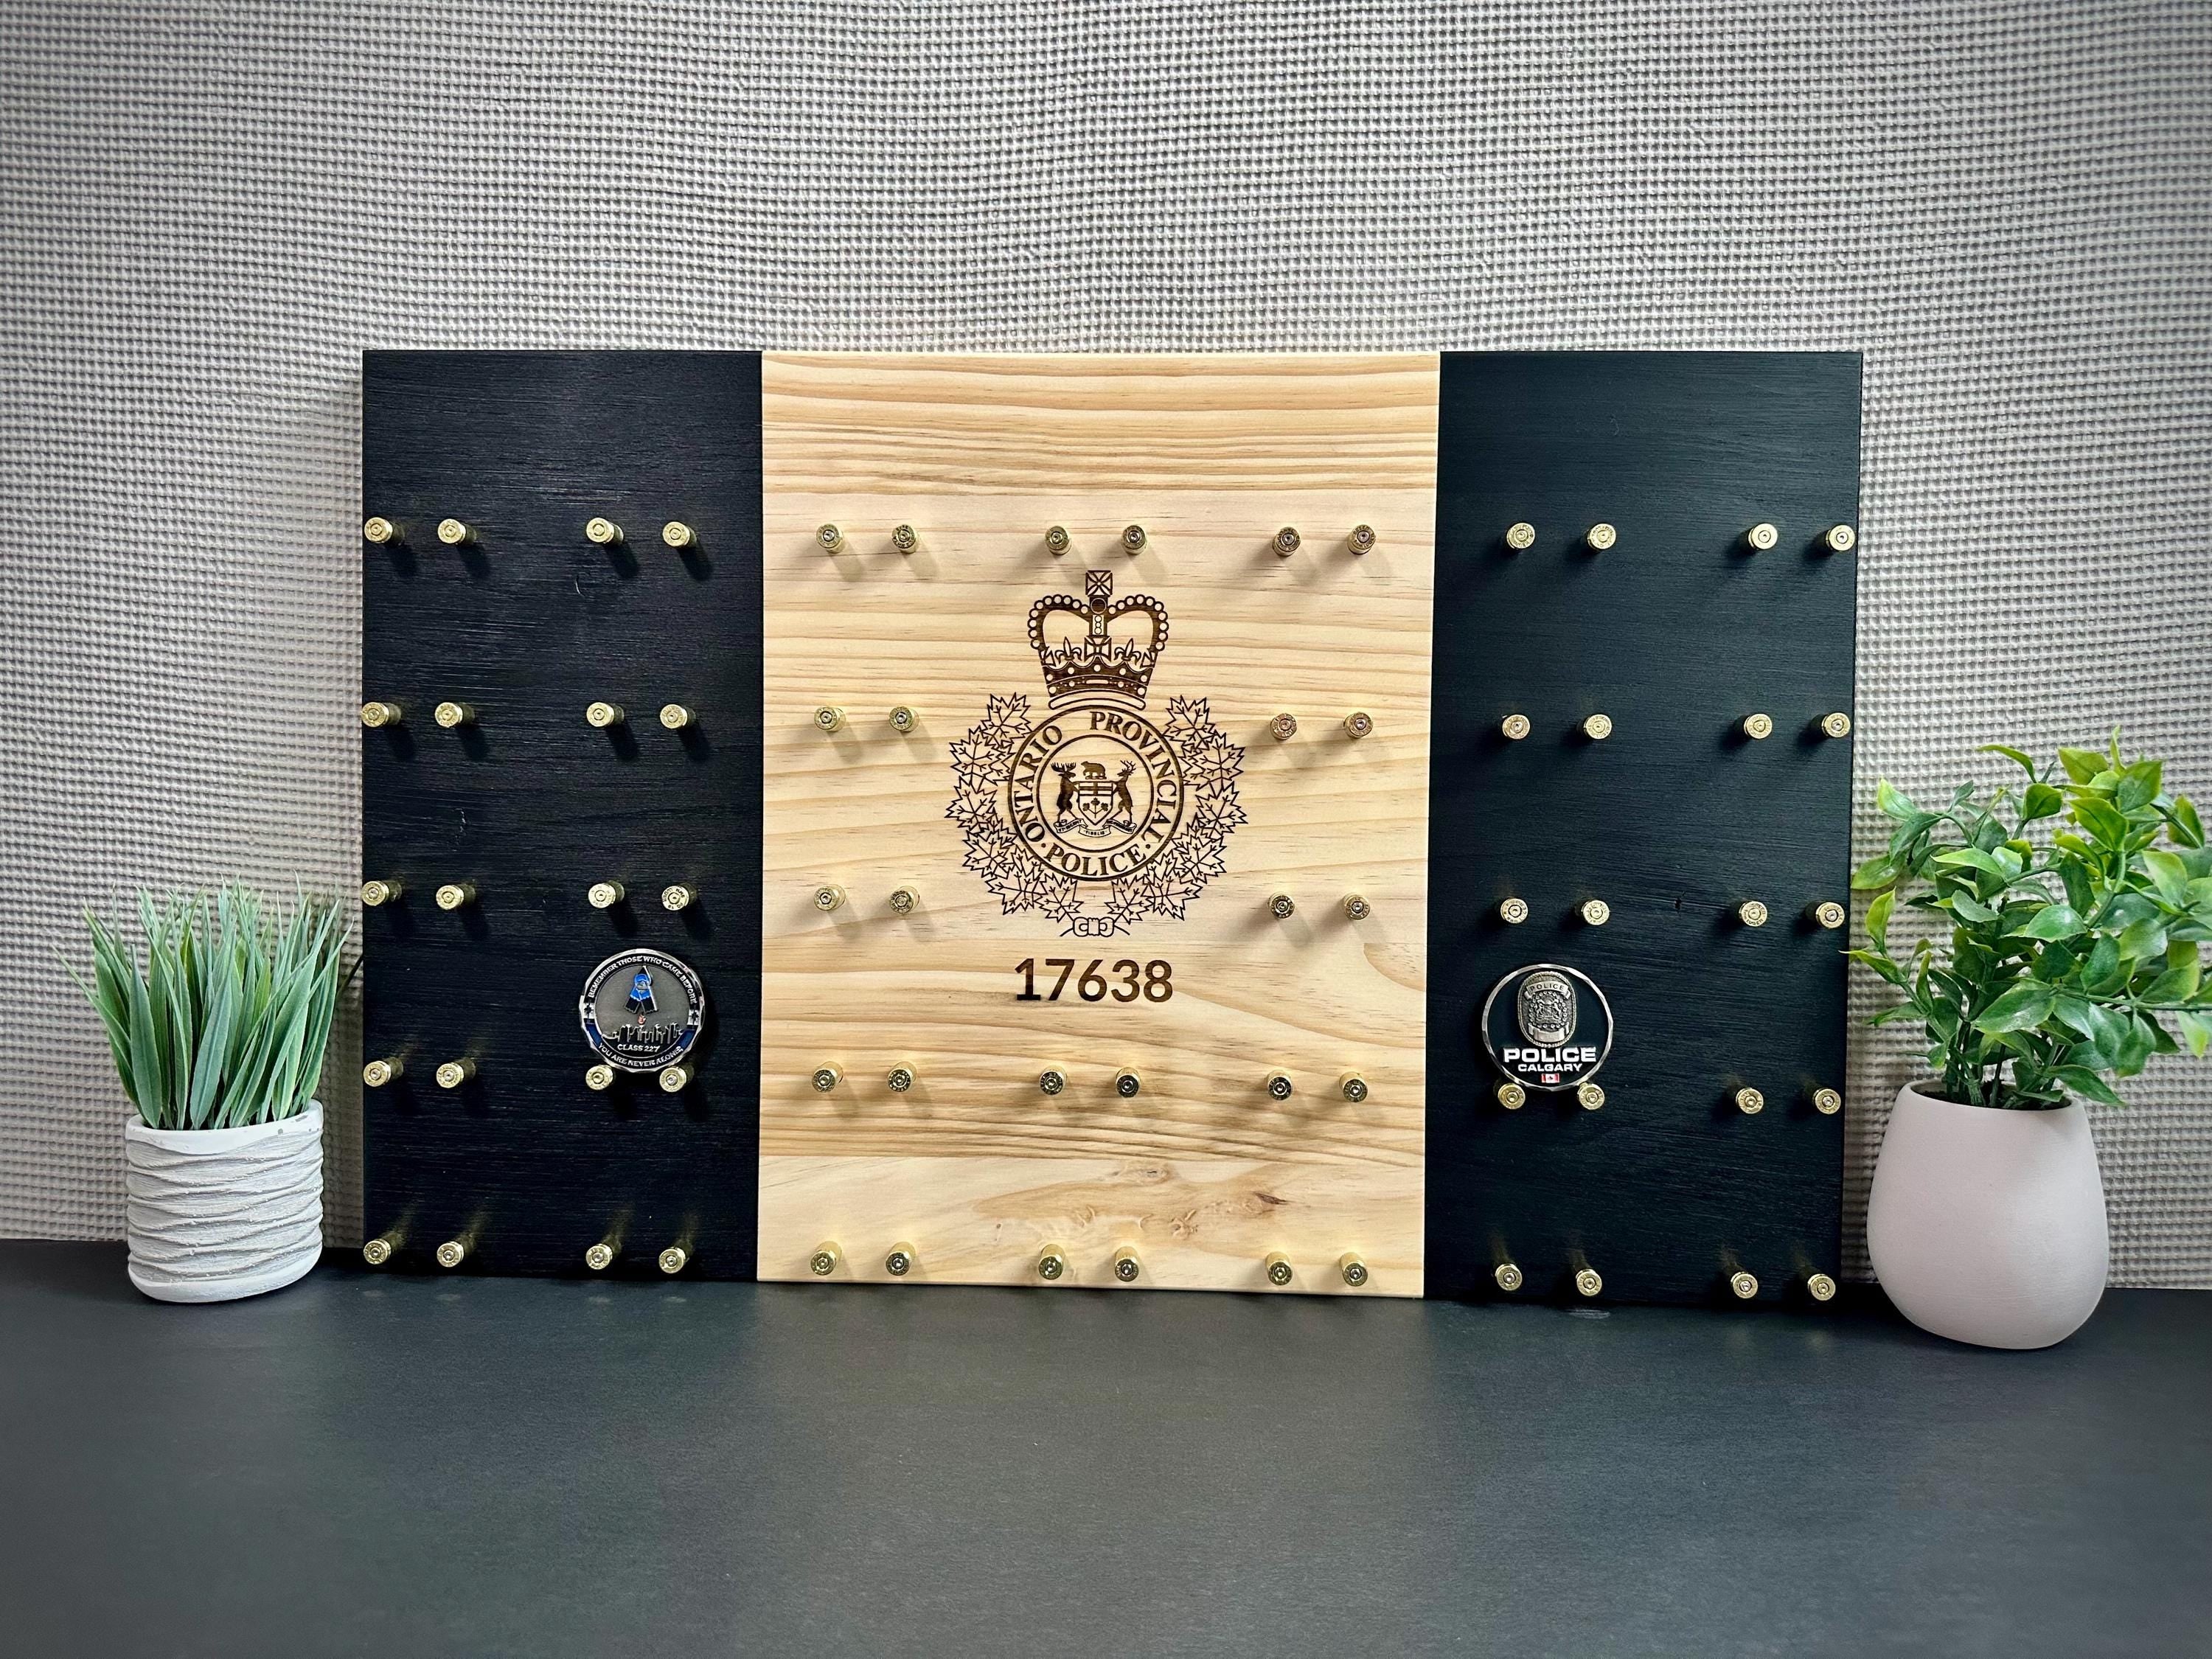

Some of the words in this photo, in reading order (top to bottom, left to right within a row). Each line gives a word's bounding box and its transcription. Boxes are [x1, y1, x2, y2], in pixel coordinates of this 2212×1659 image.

[1015, 725, 1062, 842] ONTARIO
[1090, 711, 1176, 843] PROVINCIAL
[1043, 842, 1146, 876] POLICE
[588, 964, 618, 998] REMEMBER
[617, 956, 642, 967] THOSE
[643, 956, 662, 964] WHO
[662, 961, 684, 977] CAME
[1015, 959, 1173, 1003] 17638
[598, 1043, 612, 1057] YOU
[611, 1055, 627, 1065] ARE
[1503, 1047, 1596, 1062] POLICE
[1518, 1063, 1582, 1072] CALGARY
